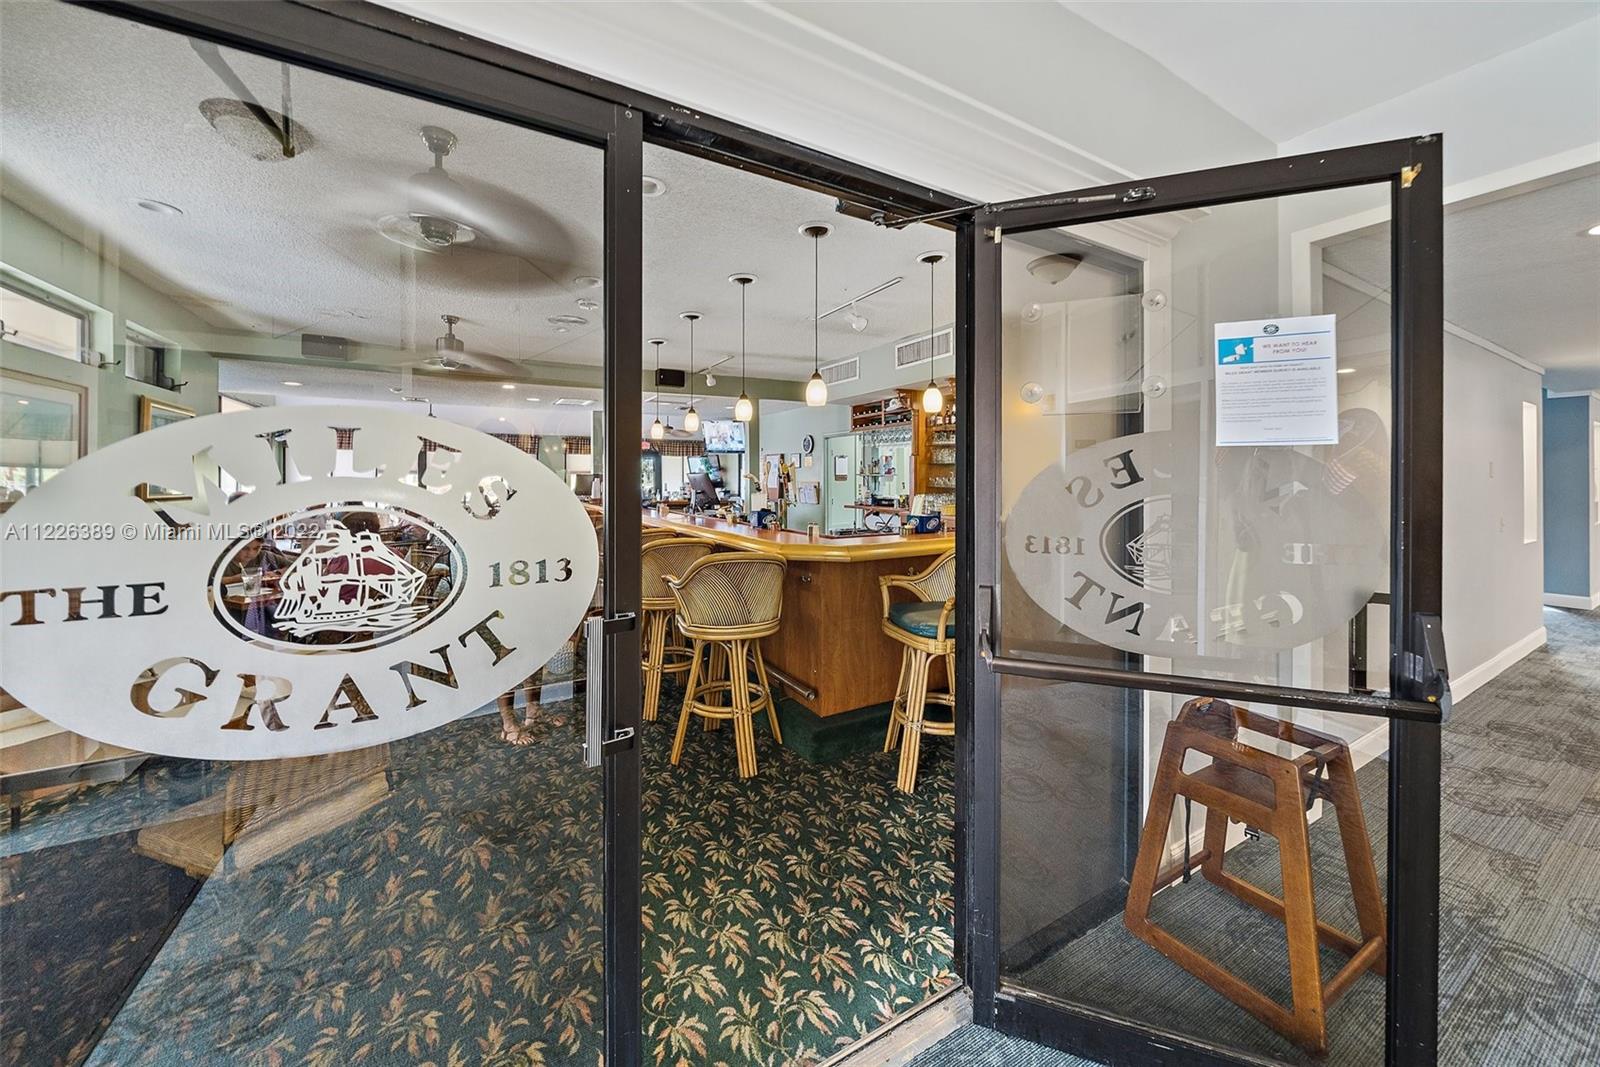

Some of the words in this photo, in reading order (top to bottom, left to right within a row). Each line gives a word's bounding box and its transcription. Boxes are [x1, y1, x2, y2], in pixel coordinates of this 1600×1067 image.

[134, 426, 518, 527] MILES
[0, 581, 169, 627] THE
[488, 557, 573, 588] 1813
[129, 609, 518, 732] GRANT
